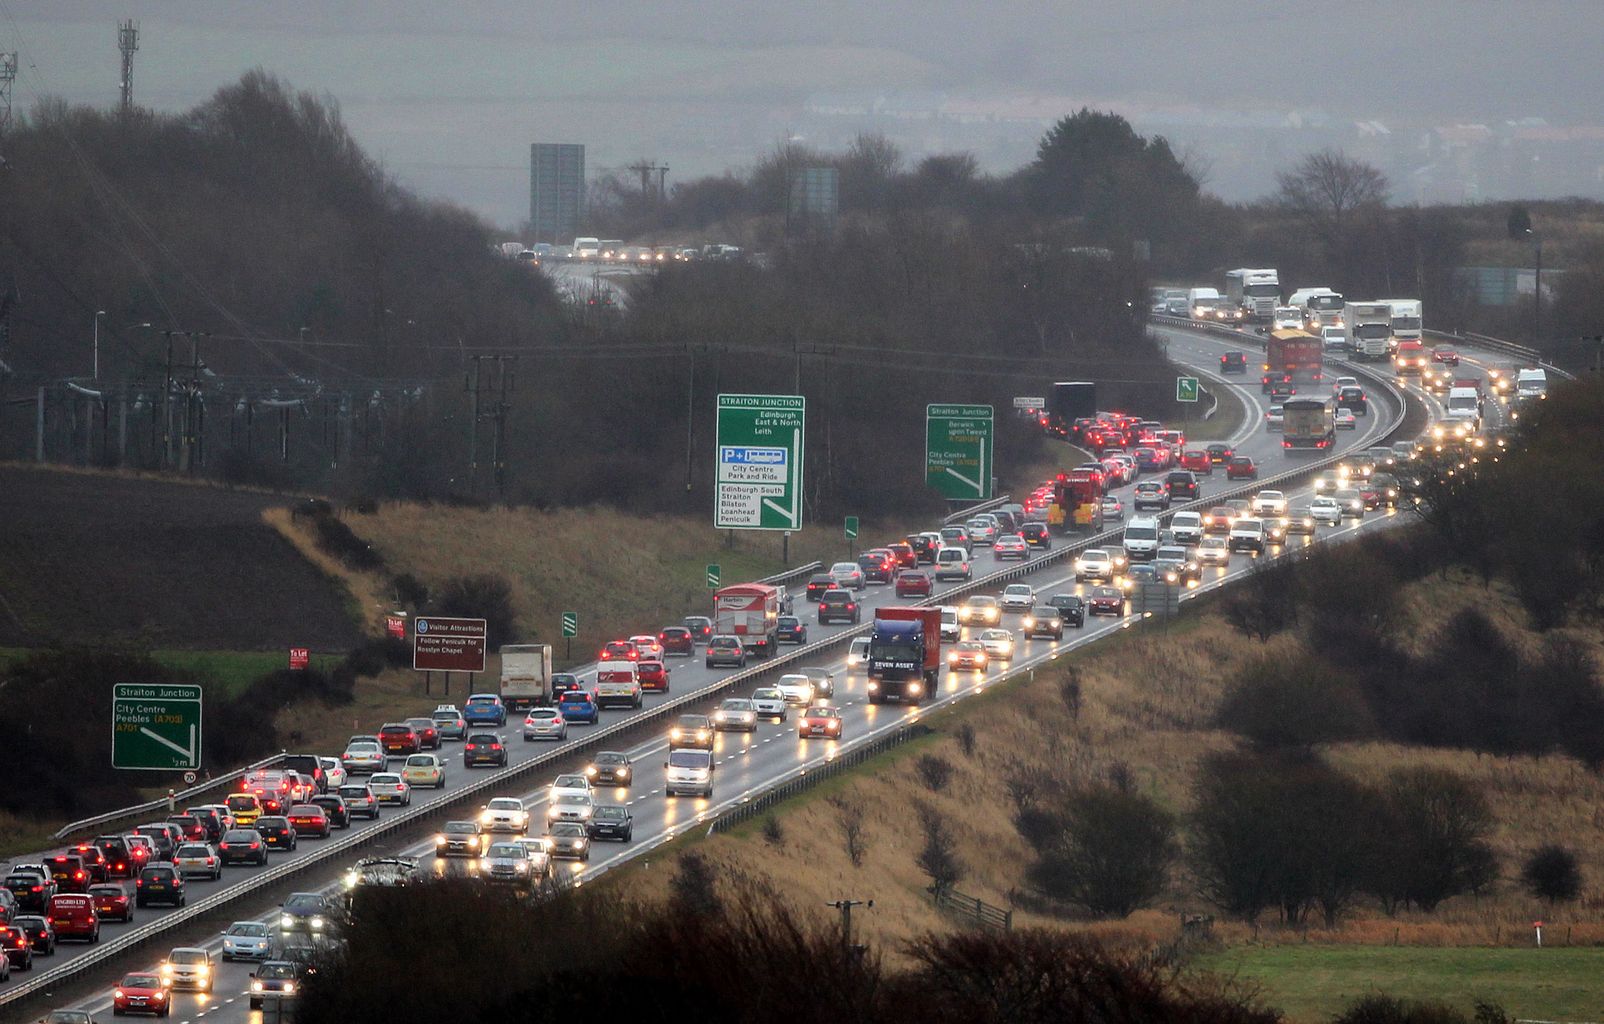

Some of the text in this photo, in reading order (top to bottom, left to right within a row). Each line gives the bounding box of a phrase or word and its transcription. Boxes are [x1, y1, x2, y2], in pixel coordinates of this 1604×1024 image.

[721, 398, 800, 407] STRAITON JUNCTION
[760, 411, 796, 420] Edinburgh
[732, 465, 774, 473] City Centre
[721, 486, 783, 494] Edinburgh South
[721, 500, 747, 508] Bilston
[721, 515, 751, 523] Penicuik
[417, 646, 440, 654] Rosslyn
[120, 688, 195, 697] Straiton Junction
[116, 704, 166, 714] City Centre
[116, 714, 150, 723] Peebles
